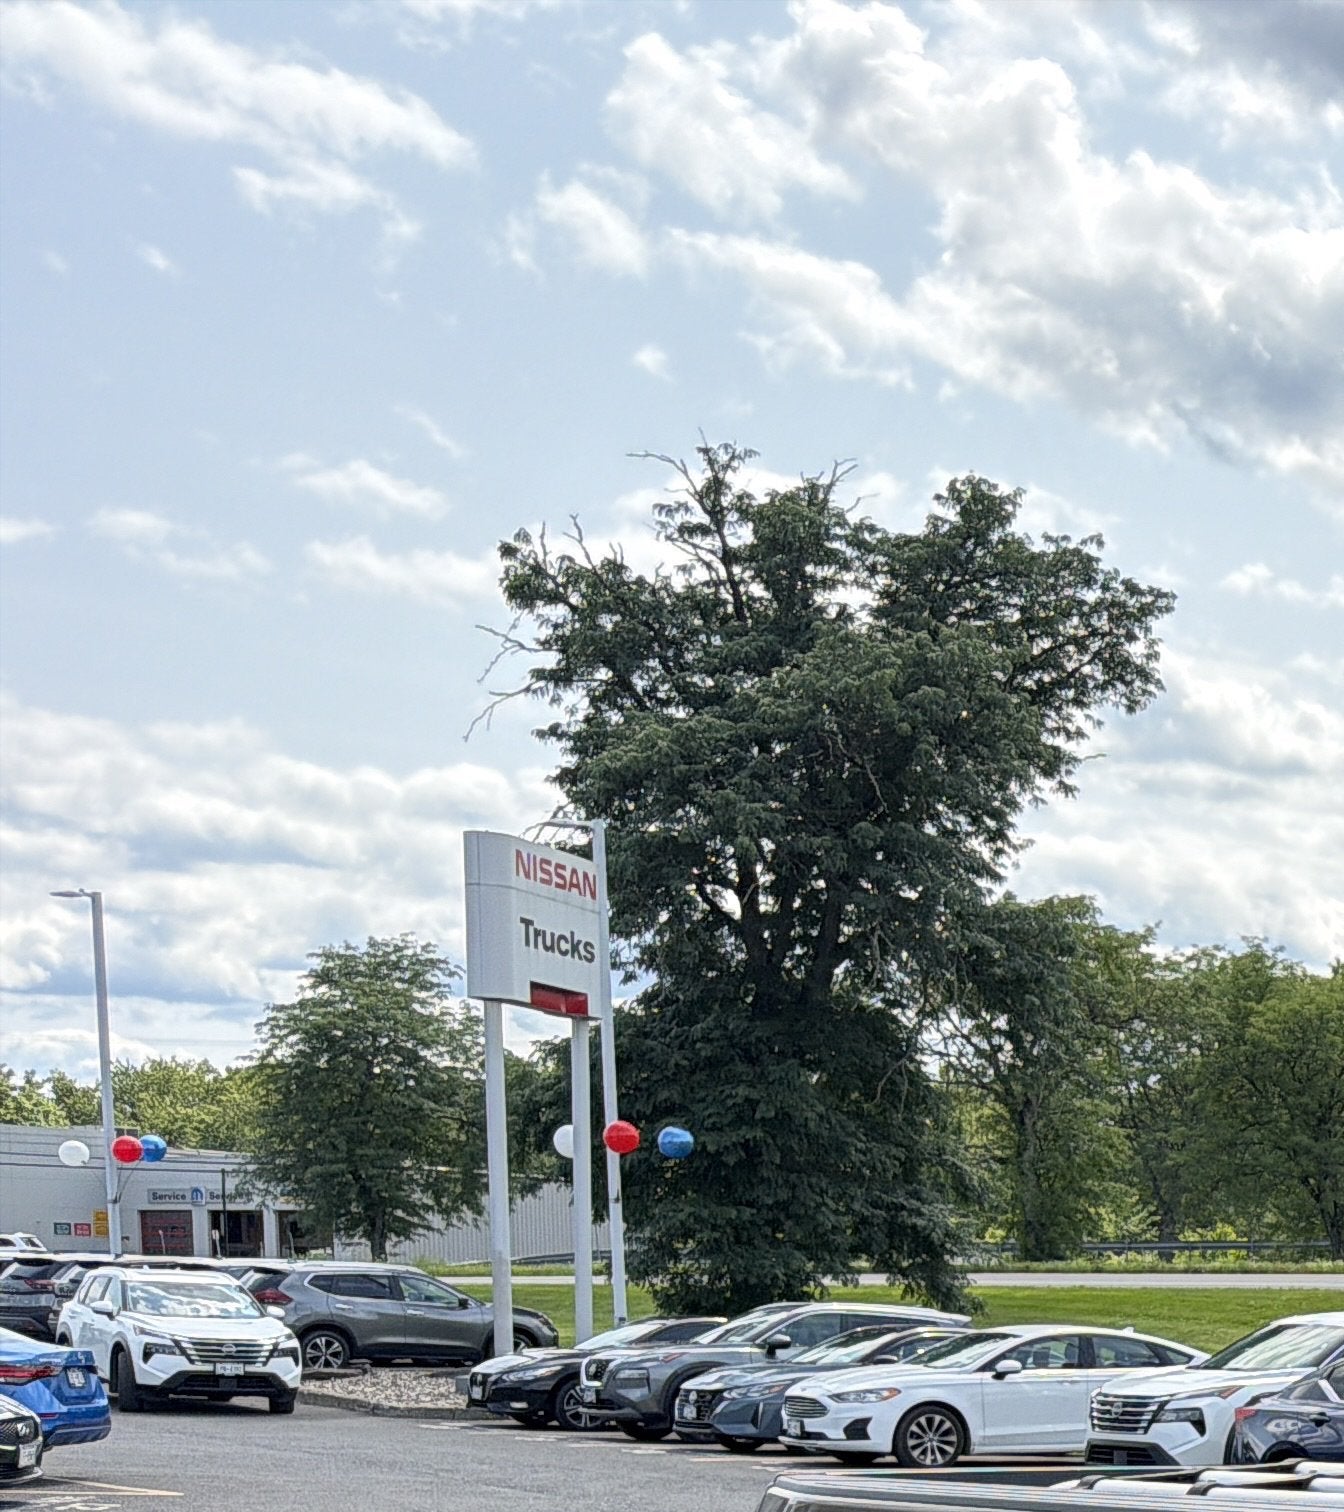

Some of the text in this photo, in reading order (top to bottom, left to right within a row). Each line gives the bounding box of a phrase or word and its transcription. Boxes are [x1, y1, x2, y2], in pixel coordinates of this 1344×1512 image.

[515, 848, 597, 901] NISSAN
[519, 916, 596, 963] Trucks
[151, 1191, 187, 1201] Service
